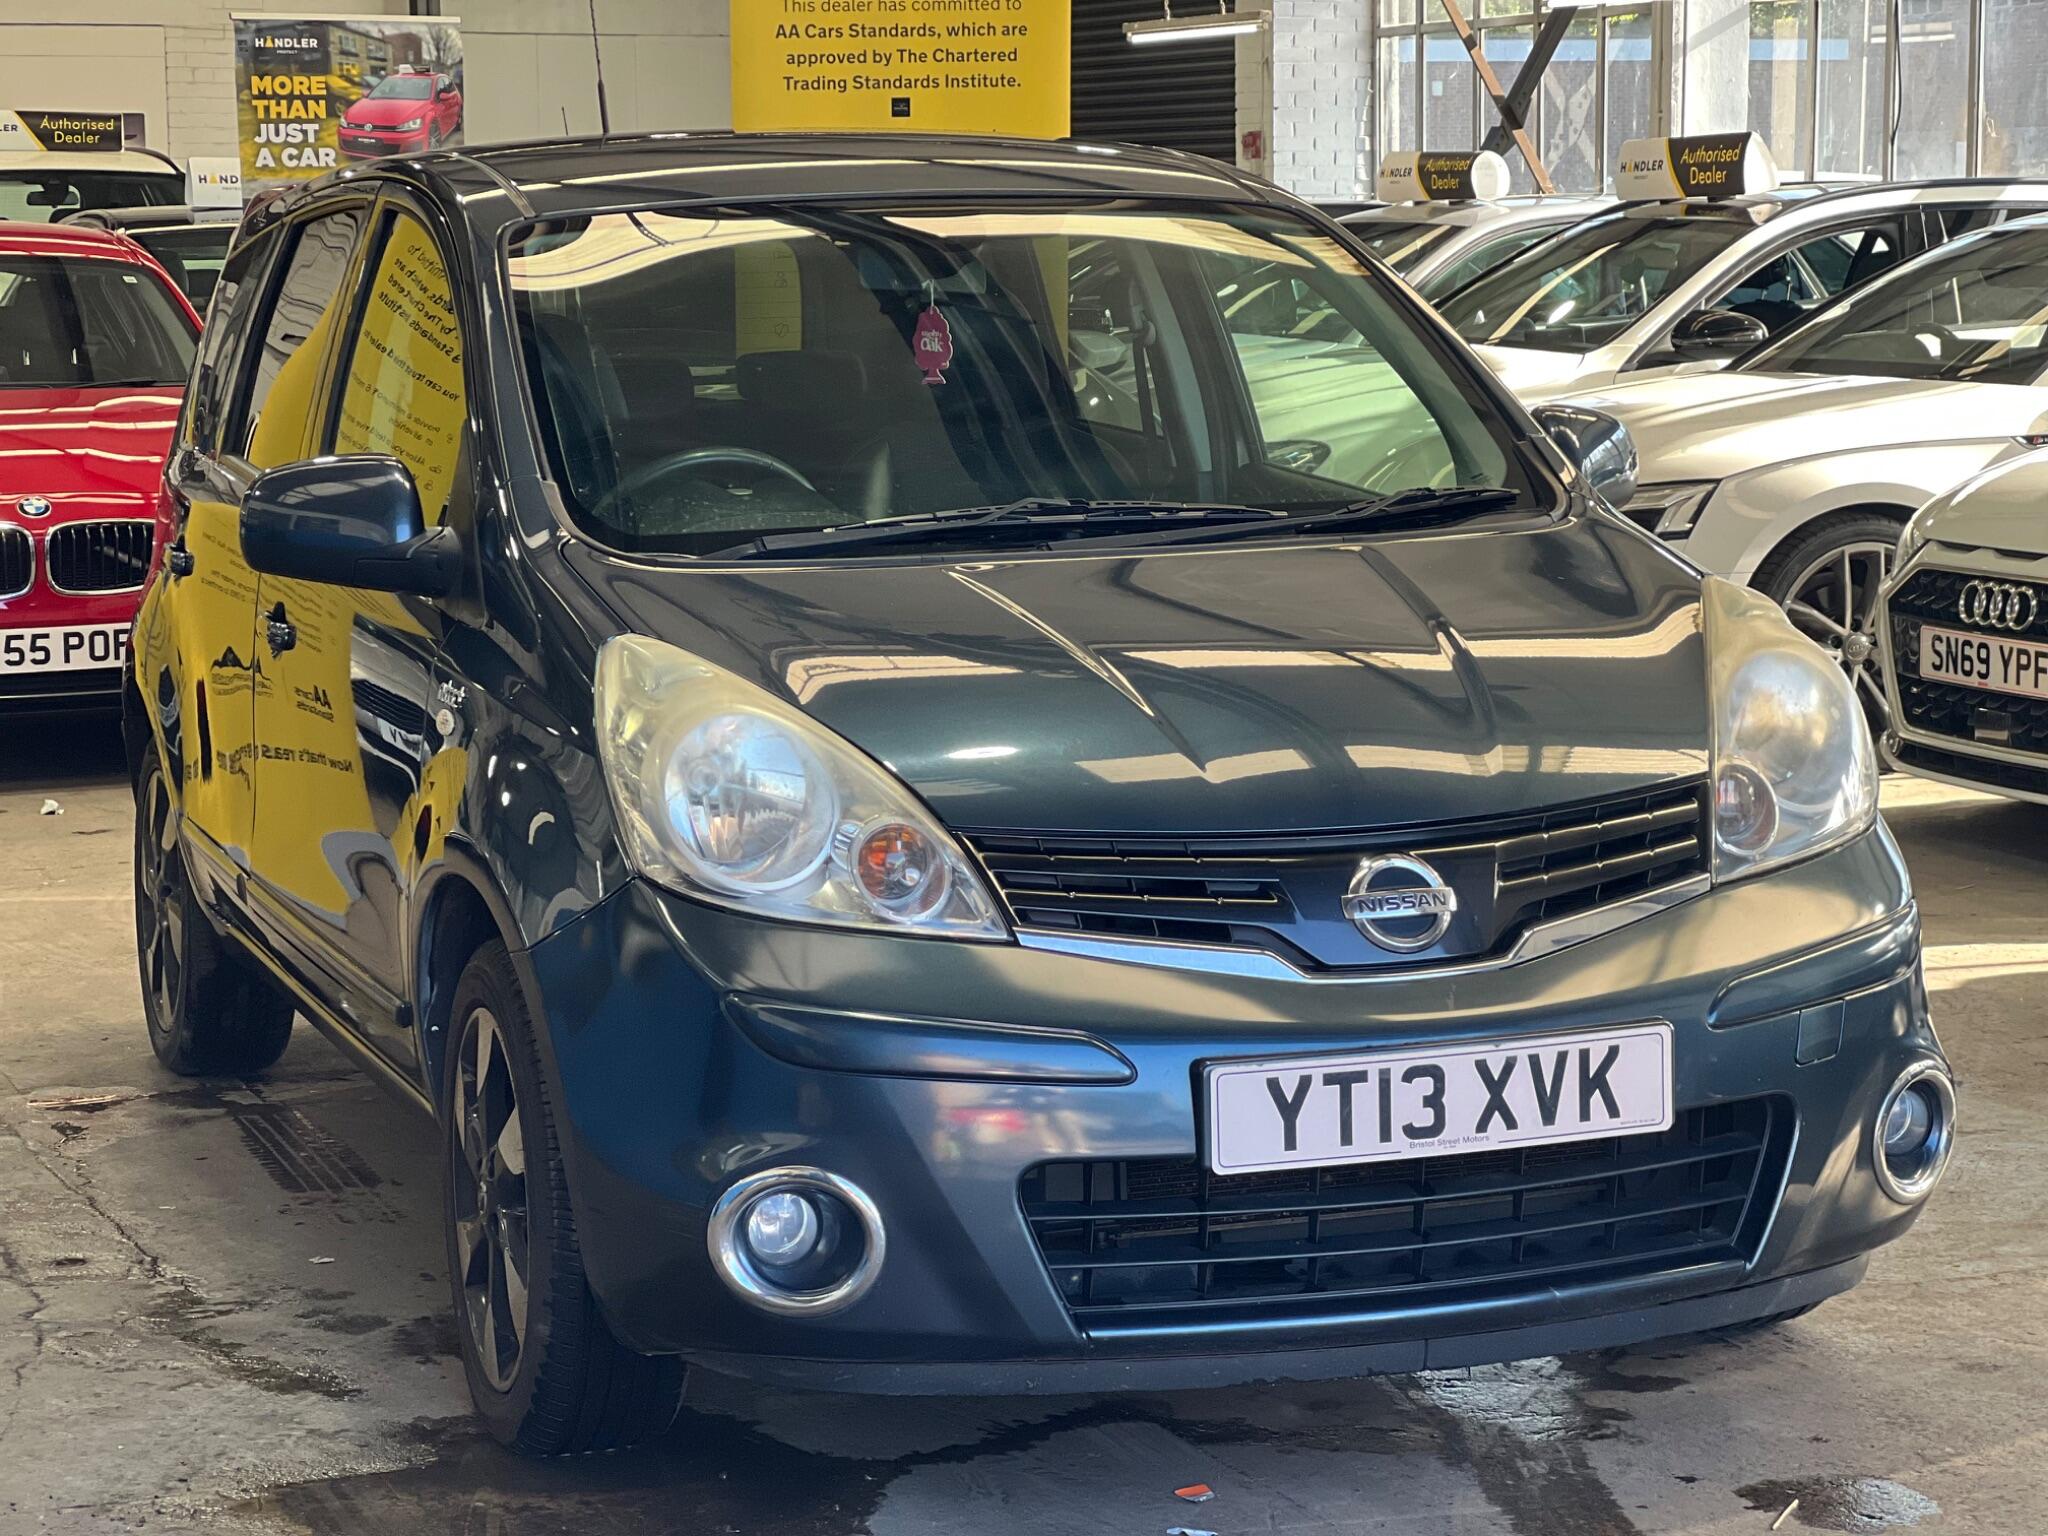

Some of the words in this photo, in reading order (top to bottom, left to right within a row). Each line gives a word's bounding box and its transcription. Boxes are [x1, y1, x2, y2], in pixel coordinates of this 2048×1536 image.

[784, 0, 816, 12] This
[821, 0, 873, 12] dealer
[878, 0, 906, 12] has
[911, 0, 1000, 11] committed
[1006, 0, 1022, 11] to
[775, 24, 800, 39] AA
[805, 23, 844, 39] Cars
[848, 22, 942, 39] Standards,
[946, 22, 997, 37] which
[1001, 24, 1028, 37] are
[786, 49, 867, 67] approved
[872, 49, 892, 67] by
[896, 48, 928, 63] The
[932, 48, 1018, 63] Chartered
[251, 75, 327, 95] MORE
[783, 76, 847, 93] Trading
[852, 74, 940, 90] Standards
[945, 73, 1022, 88] Institute.
[252, 99, 327, 119] THAN
[40, 115, 114, 130] Authorised
[54, 131, 101, 144] Dealer
[254, 123, 319, 144] JUST
[255, 147, 276, 168] A
[281, 147, 336, 168] CAR
[1680, 142, 1743, 165] Authorised
[1424, 156, 1473, 172] Authorised
[1431, 174, 1460, 190] Dealer
[1689, 165, 1727, 185] Dealer
[4, 633, 50, 666] 55
[1931, 634, 1991, 680] SN69
[2000, 645, 2048, 688] YPF
[1358, 892, 1447, 914] NISSAN
[1266, 1064, 1446, 1152] YT13
[1474, 1044, 1621, 1134] XVK
[1409, 1140, 1435, 1149] Bristol
[1437, 1137, 1461, 1147] Street
[1463, 1135, 1490, 1144] Motors
